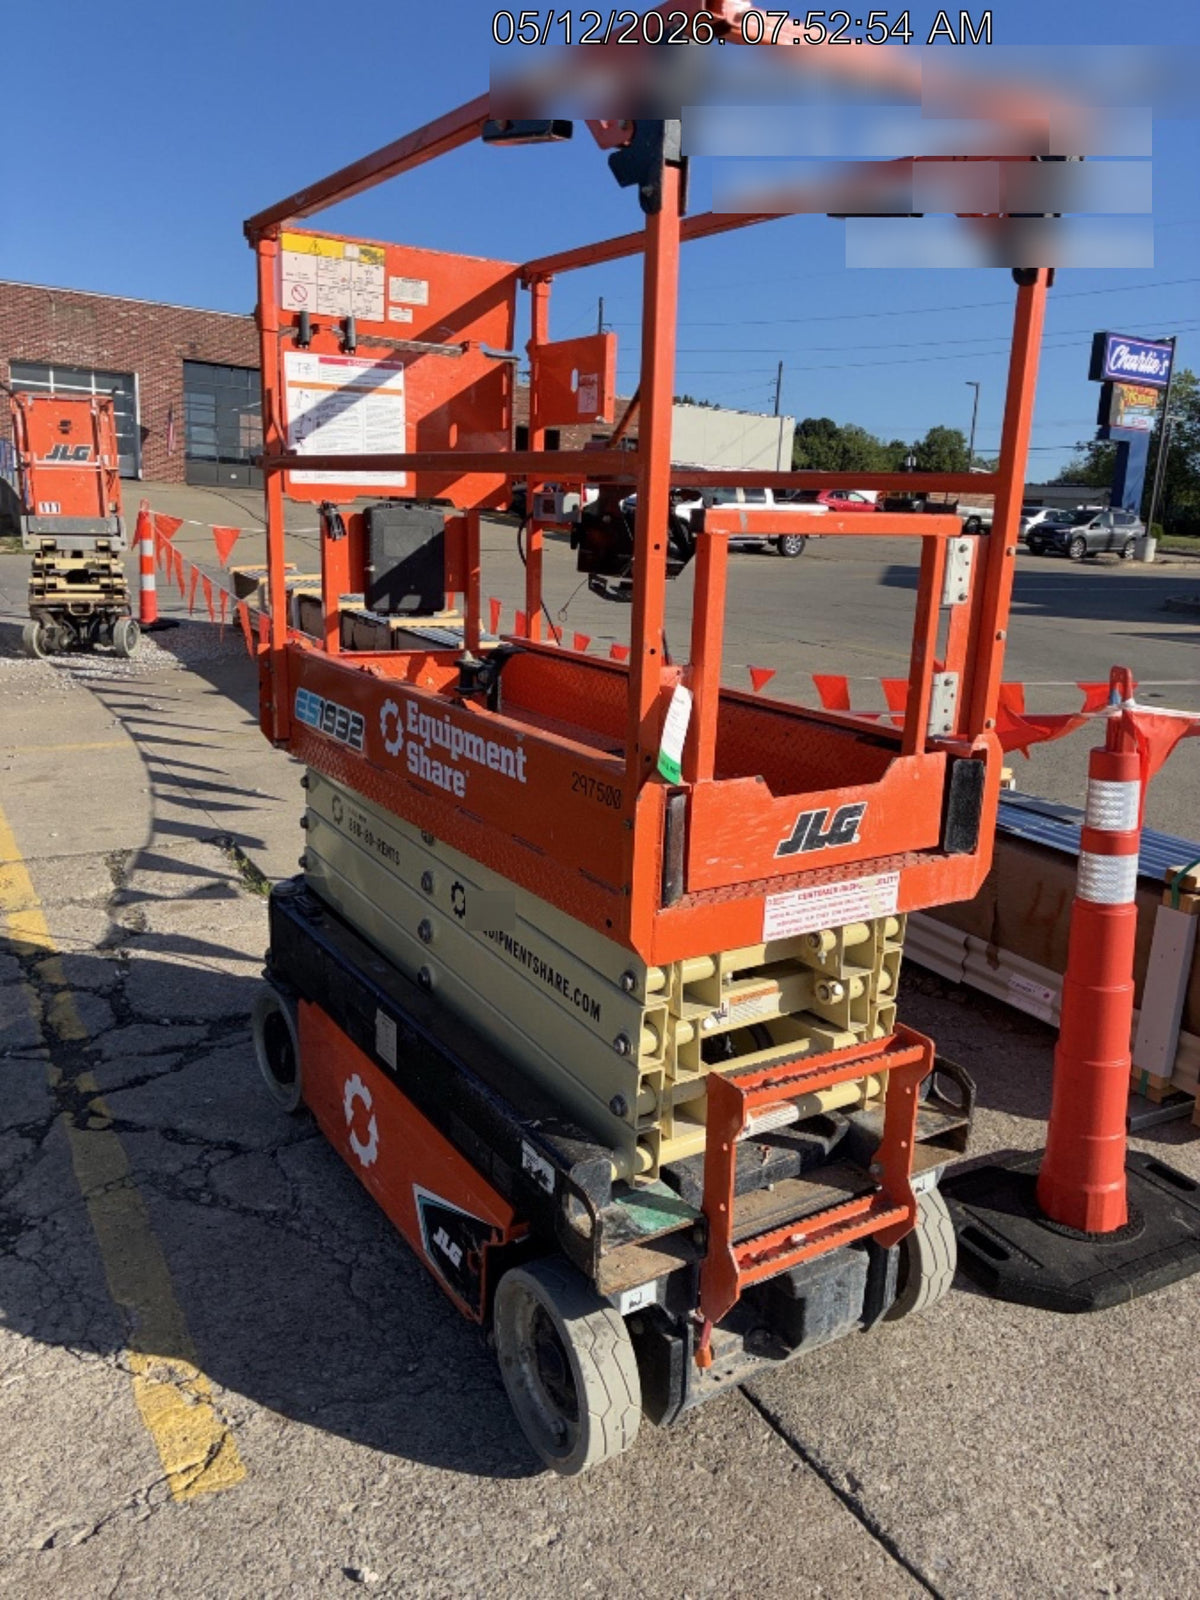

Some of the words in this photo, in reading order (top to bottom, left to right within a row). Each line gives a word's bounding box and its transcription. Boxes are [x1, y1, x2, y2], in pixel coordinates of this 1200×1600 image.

[1109, 344, 1169, 376] Charlie's
[44, 443, 93, 463] JLG
[295, 688, 364, 750] ES1932
[406, 700, 527, 783] Equipment
[406, 740, 467, 798] Share
[773, 801, 868, 859] JLG
[432, 1225, 463, 1269] JLG
